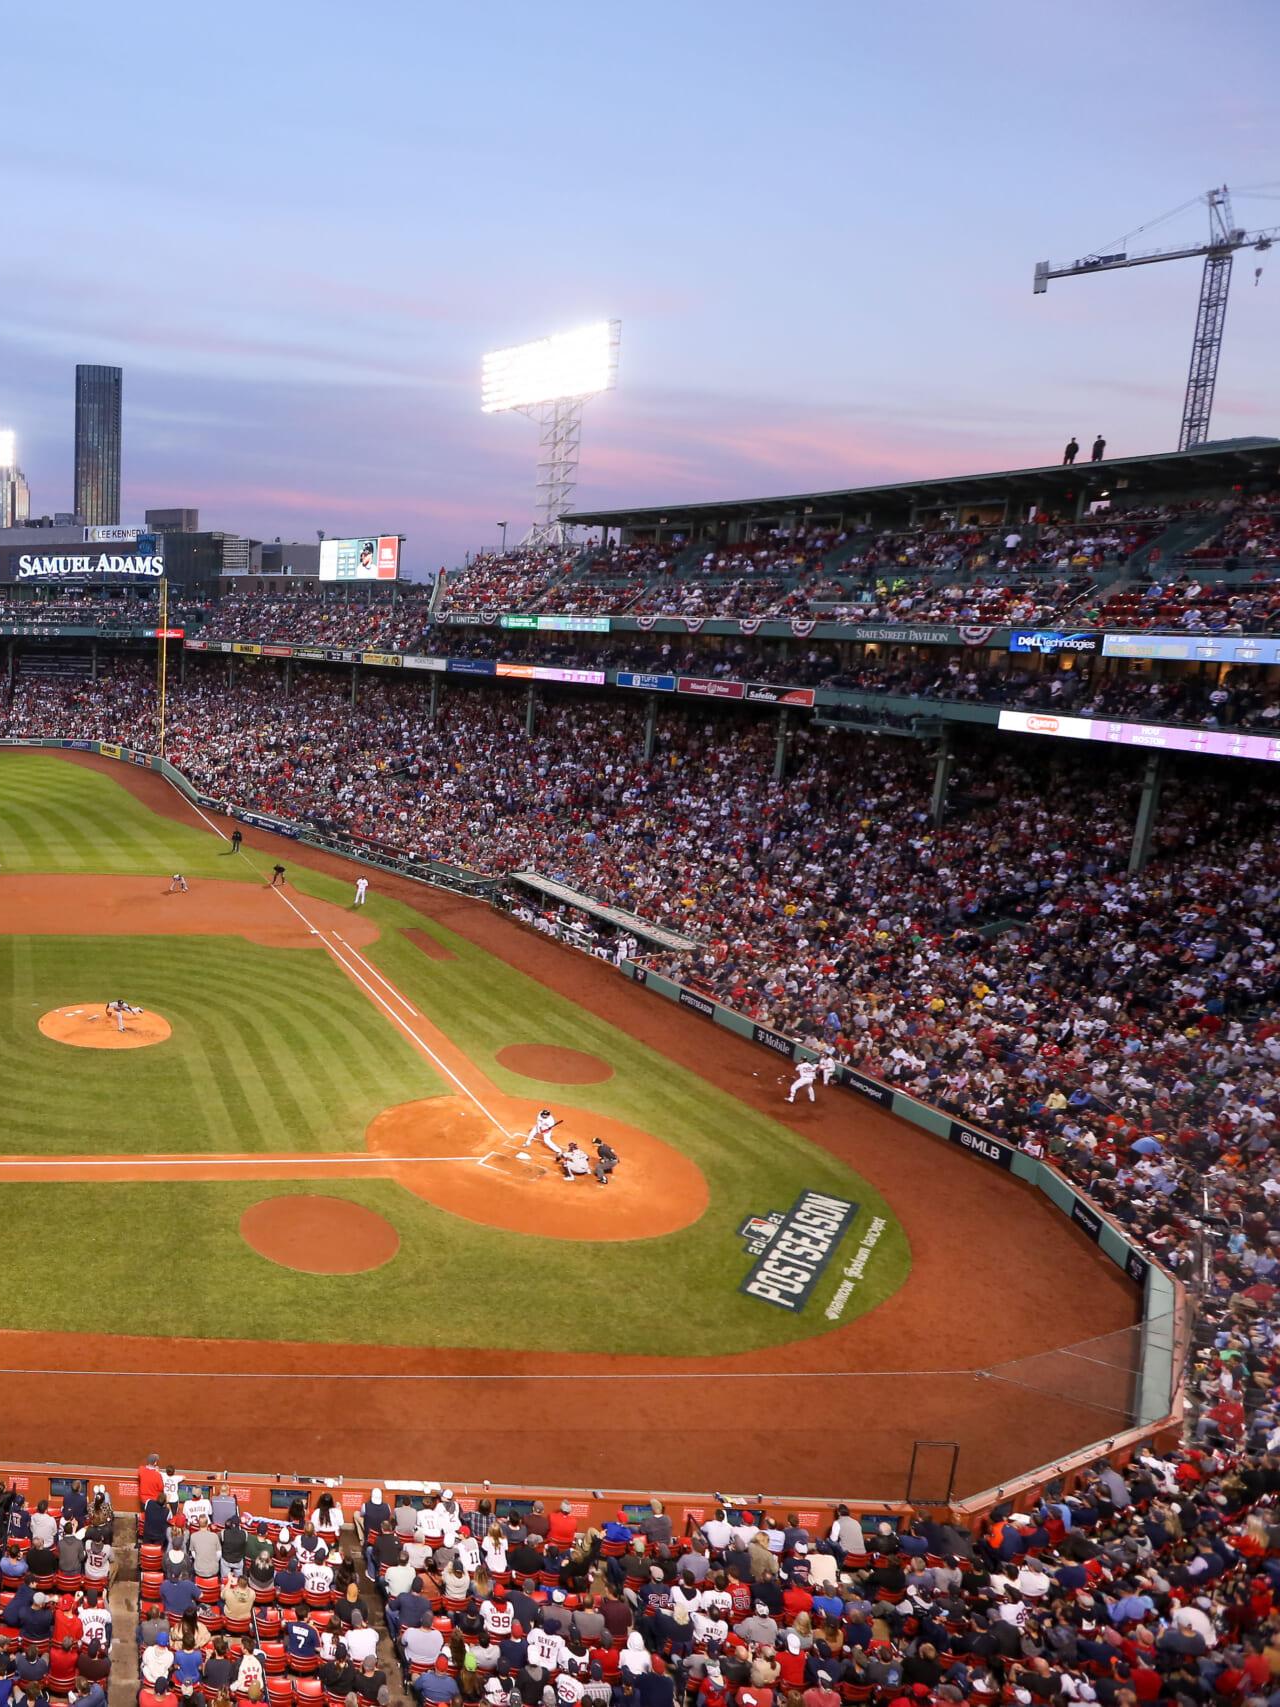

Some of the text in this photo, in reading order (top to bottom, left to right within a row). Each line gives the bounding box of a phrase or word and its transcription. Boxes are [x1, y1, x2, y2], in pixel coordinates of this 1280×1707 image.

[98, 530, 110, 539] LEE
[18, 554, 164, 578] SAMUEL ADAMS
[856, 628, 949, 642] STATE STREET PAVILION
[1018, 636, 1042, 646] DELL
[1042, 637, 1095, 650] Technologies
[641, 676, 658, 684] TUFTS
[749, 690, 777, 701] Safelite
[1132, 735, 1166, 746] BOSTON
[680, 992, 712, 1015] #POSTSEASON
[765, 1033, 790, 1054] Mobile
[961, 1131, 1000, 1160] @MLB
[746, 1192, 851, 1308] POSTSEASON
[748, 1236, 767, 1255] 20
[88, 1555, 104, 1568] 15
[491, 1616, 510, 1628] 99
[297, 1636, 305, 1648] 7
[537, 1636, 558, 1648] DEVERS
[540, 1646, 551, 1659] 11
